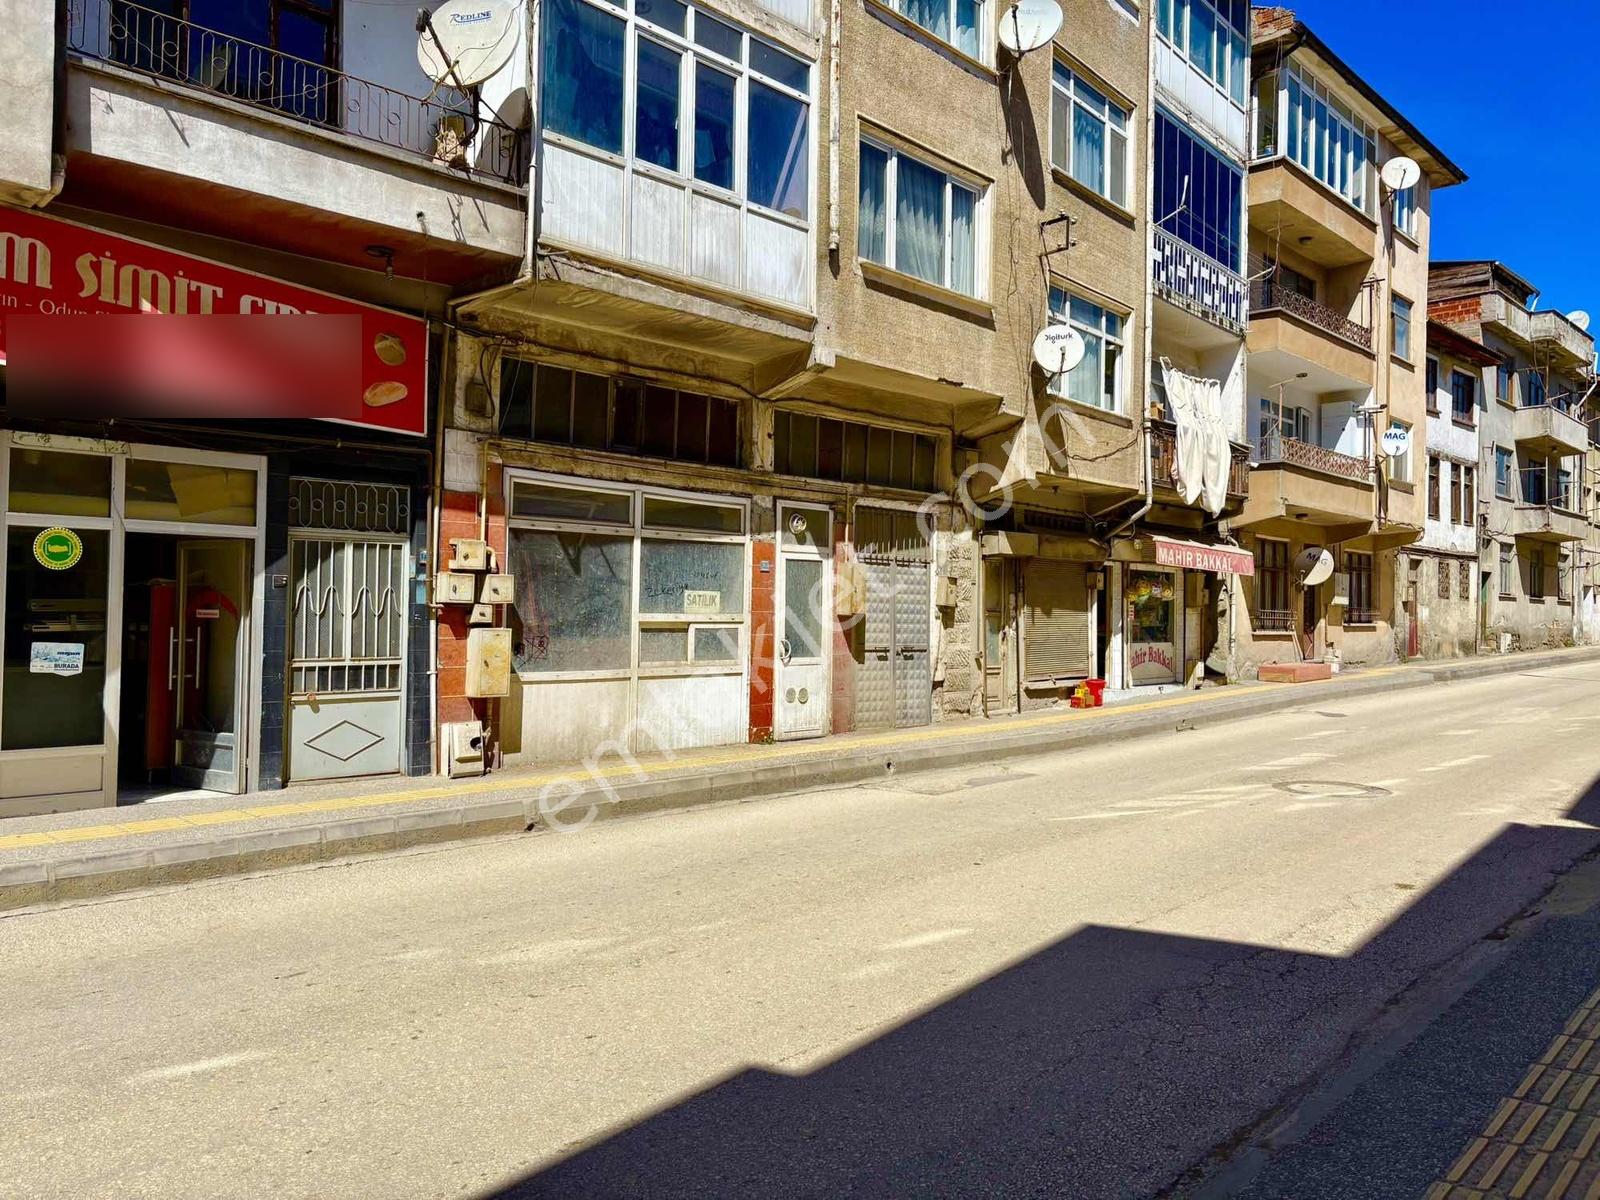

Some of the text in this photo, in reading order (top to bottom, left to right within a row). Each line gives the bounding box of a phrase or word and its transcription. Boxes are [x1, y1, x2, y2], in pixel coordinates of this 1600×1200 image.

[450, 10, 492, 24] REDLINE
[1384, 432, 1406, 440] MAG
[1196, 552, 1233, 571] BAKKAL
[686, 593, 717, 608] SATILIK
[1130, 650, 1147, 669] ahir
